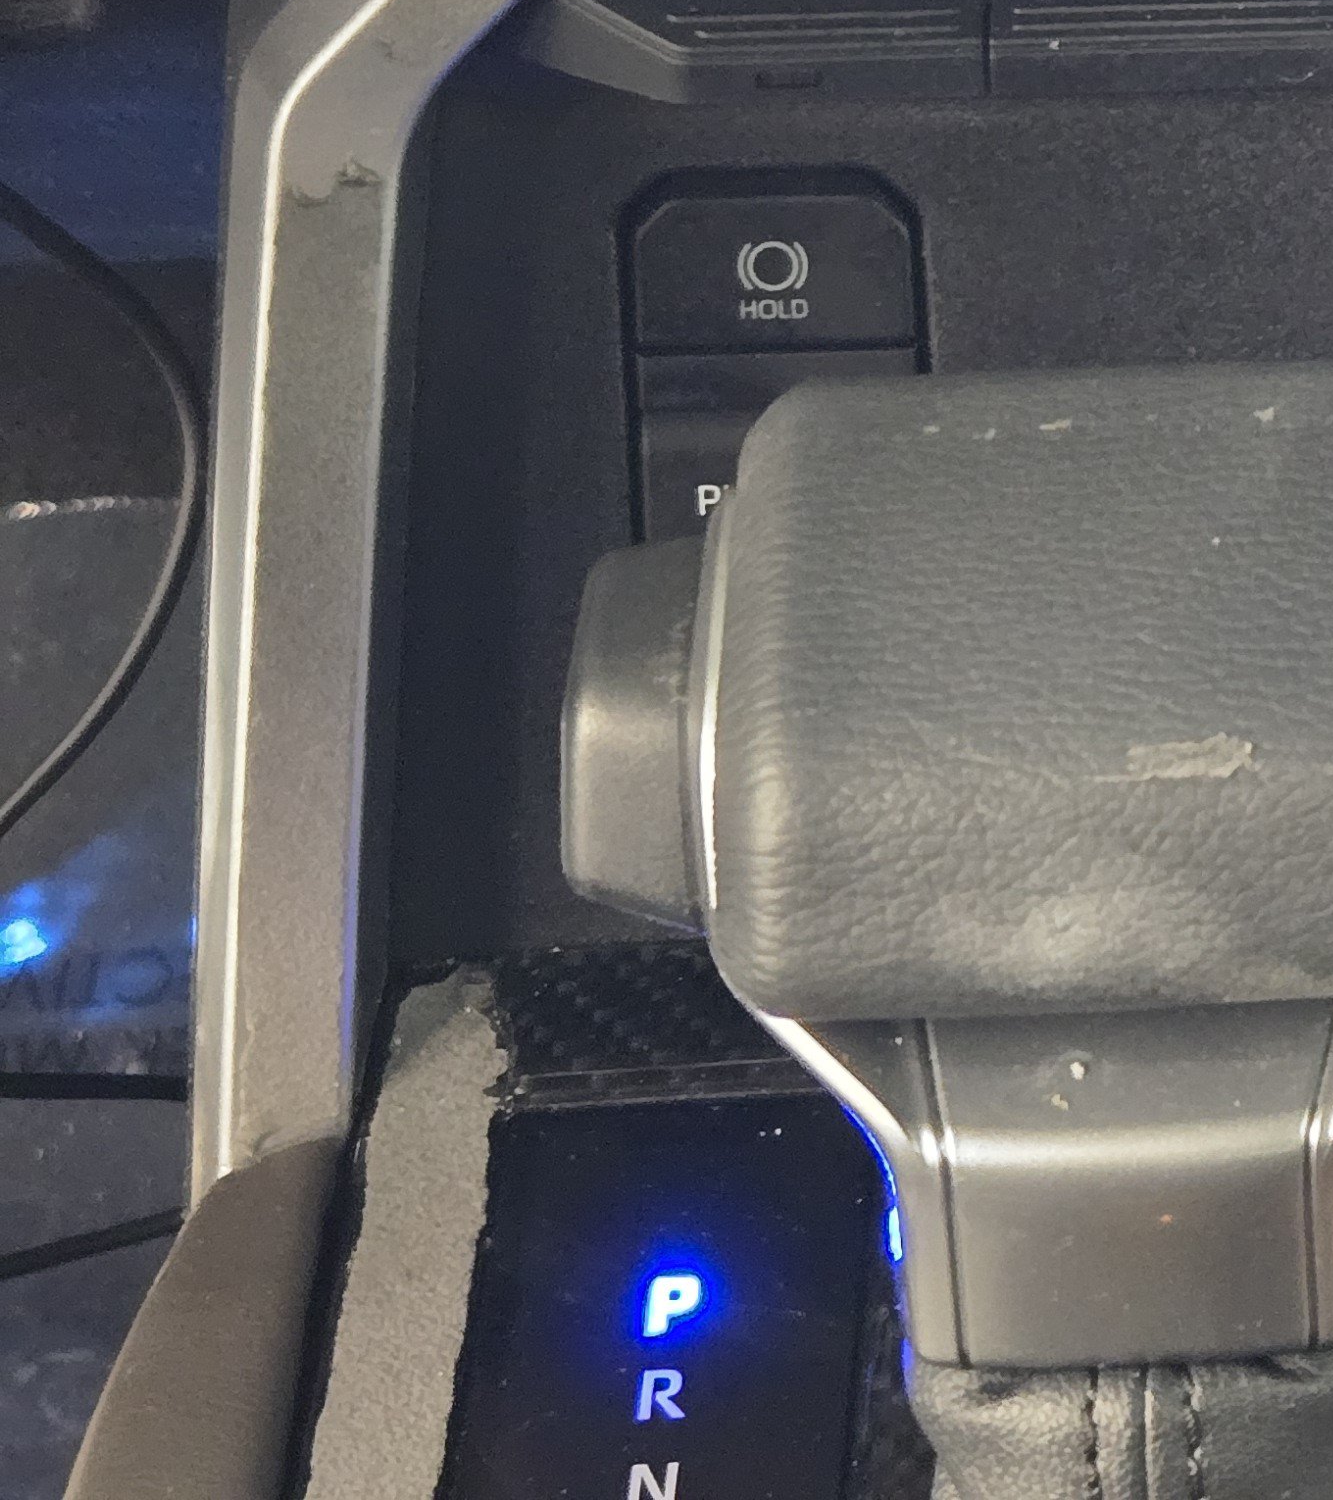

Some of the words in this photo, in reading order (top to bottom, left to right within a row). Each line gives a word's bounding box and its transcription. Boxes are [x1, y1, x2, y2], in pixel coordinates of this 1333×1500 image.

[739, 299, 809, 320] HOLD
[644, 1274, 702, 1337] P
[636, 1368, 686, 1422] R
[627, 1461, 680, 1500] N
